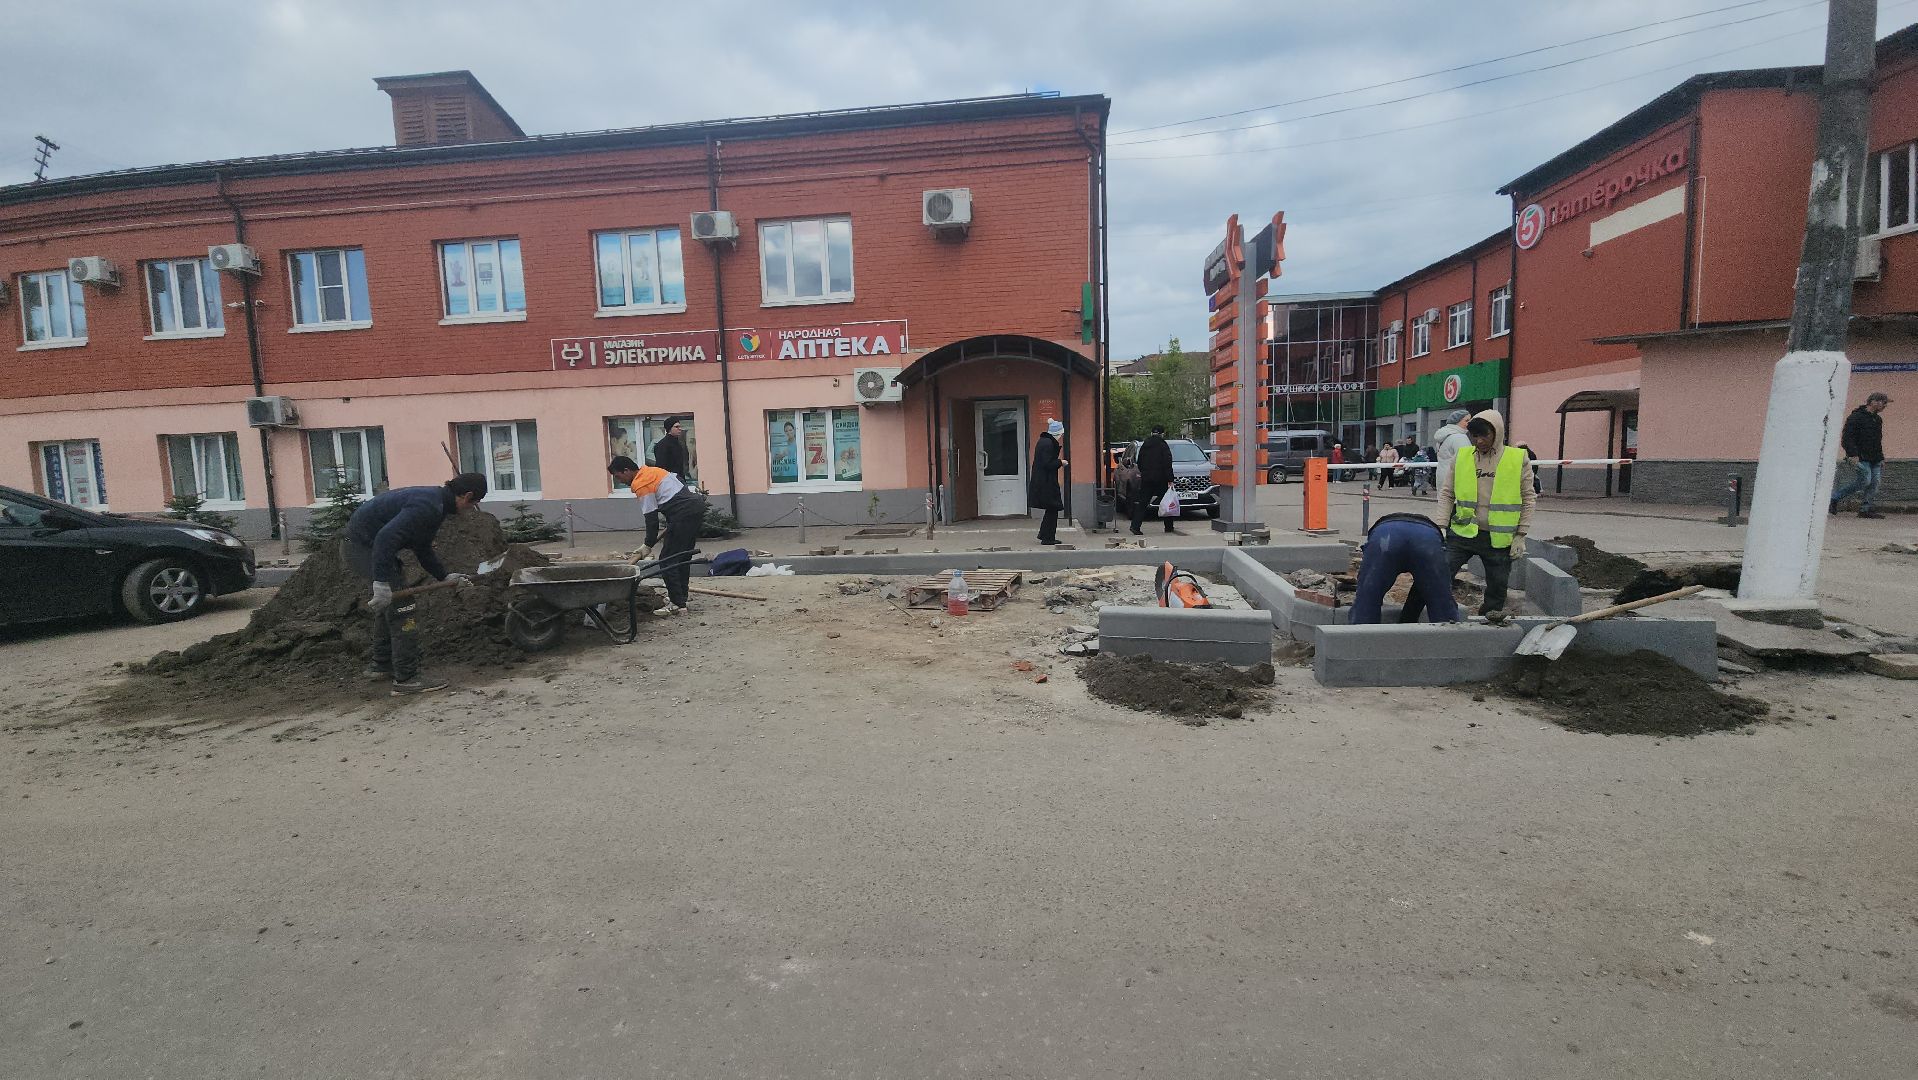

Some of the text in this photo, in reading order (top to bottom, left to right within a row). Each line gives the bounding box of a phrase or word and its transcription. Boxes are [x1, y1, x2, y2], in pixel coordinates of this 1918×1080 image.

[1521, 209, 1536, 241] 5
[778, 328, 841, 340] НАРОДНАЯ
[603, 339, 645, 349] МАГАЗИН
[778, 335, 891, 360] АПТЕКА
[604, 345, 706, 365] ЭЛЕКТРИКА
[808, 446, 825, 464] 7%
